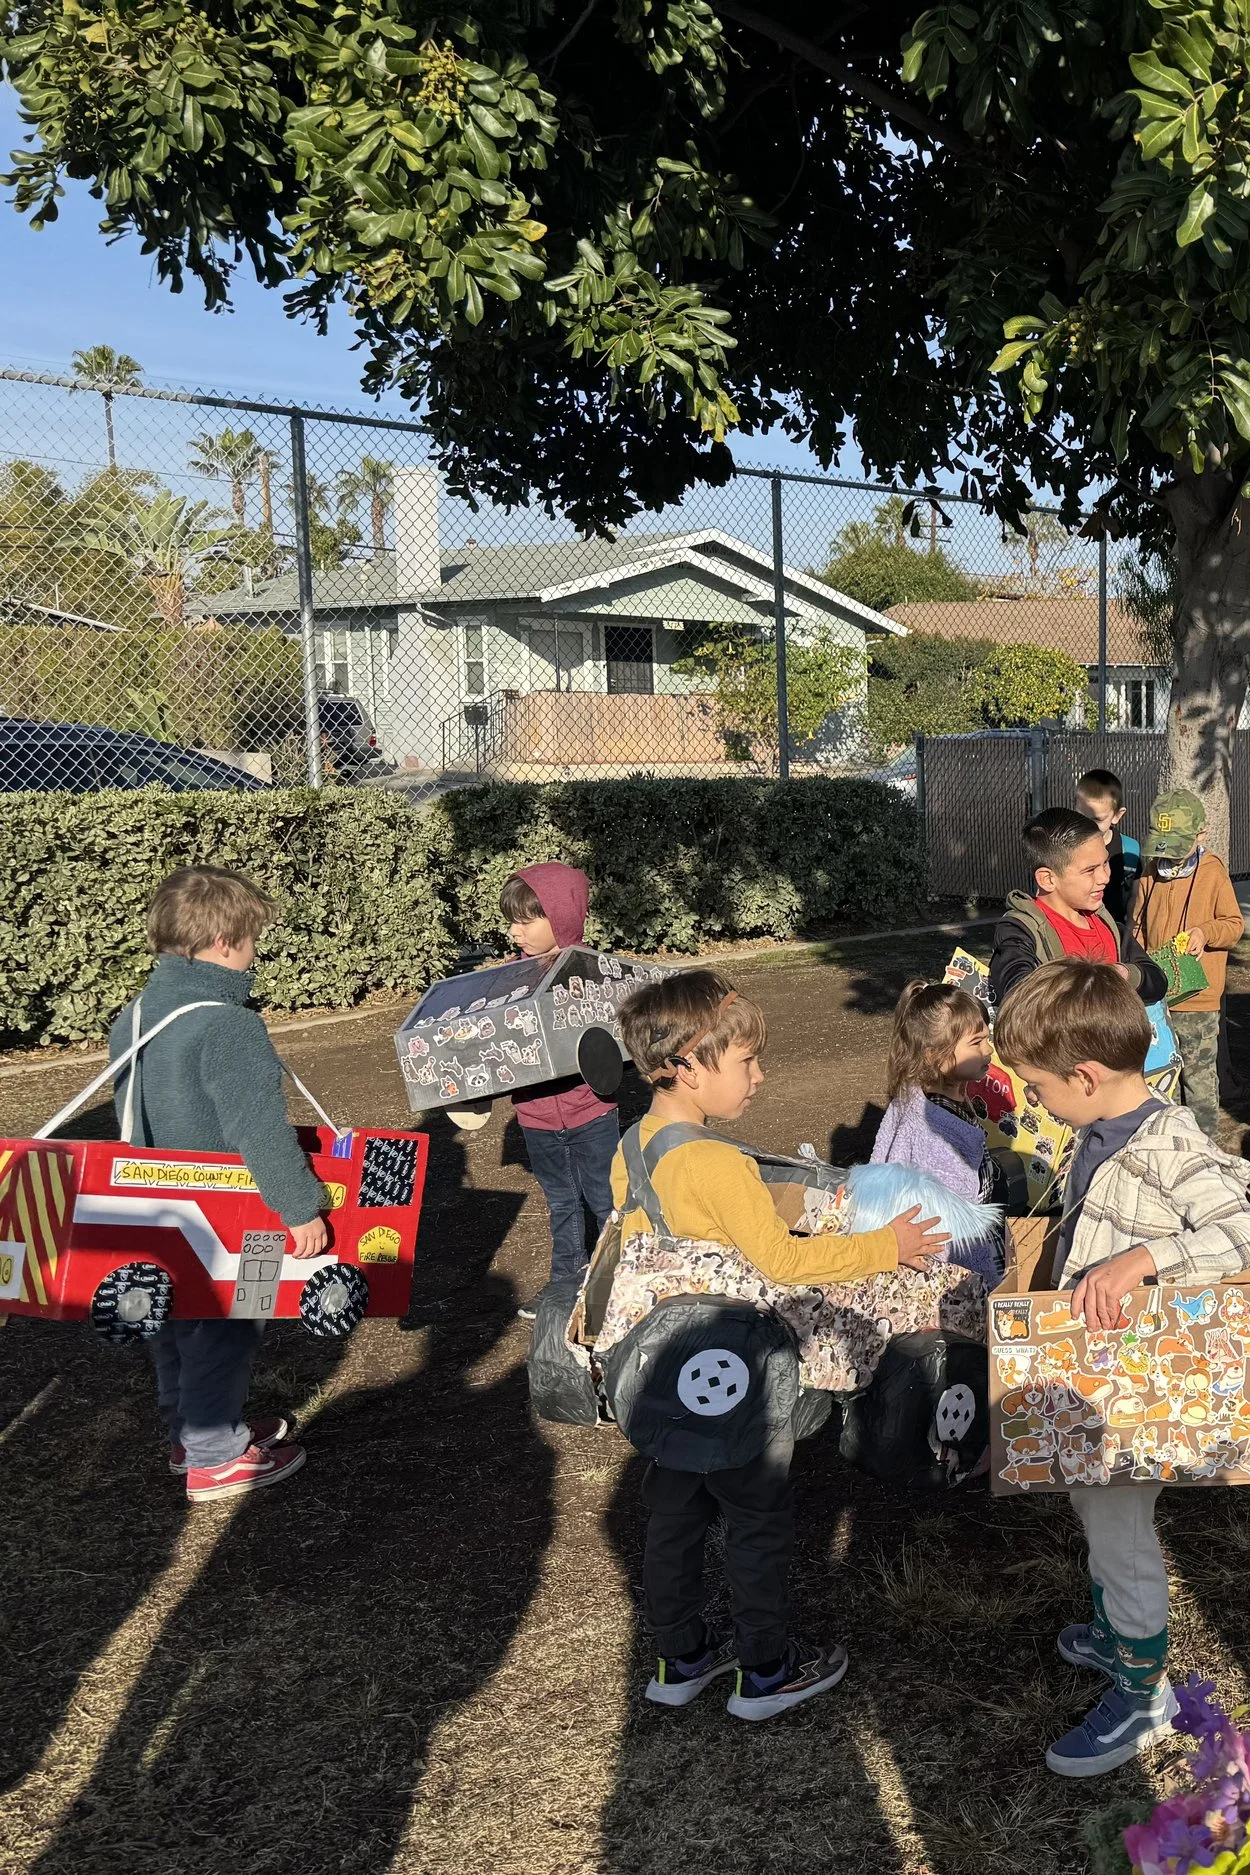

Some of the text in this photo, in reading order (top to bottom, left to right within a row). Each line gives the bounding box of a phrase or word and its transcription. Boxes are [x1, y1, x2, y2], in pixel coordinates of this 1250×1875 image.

[976, 1073, 1010, 1097] TOP
[122, 1166, 154, 1181] SAN
[157, 1168, 190, 1182] DIEGO
[193, 1171, 234, 1184] COUNTY
[360, 1231, 376, 1246] SAN
[360, 1251, 376, 1261] FIRE
